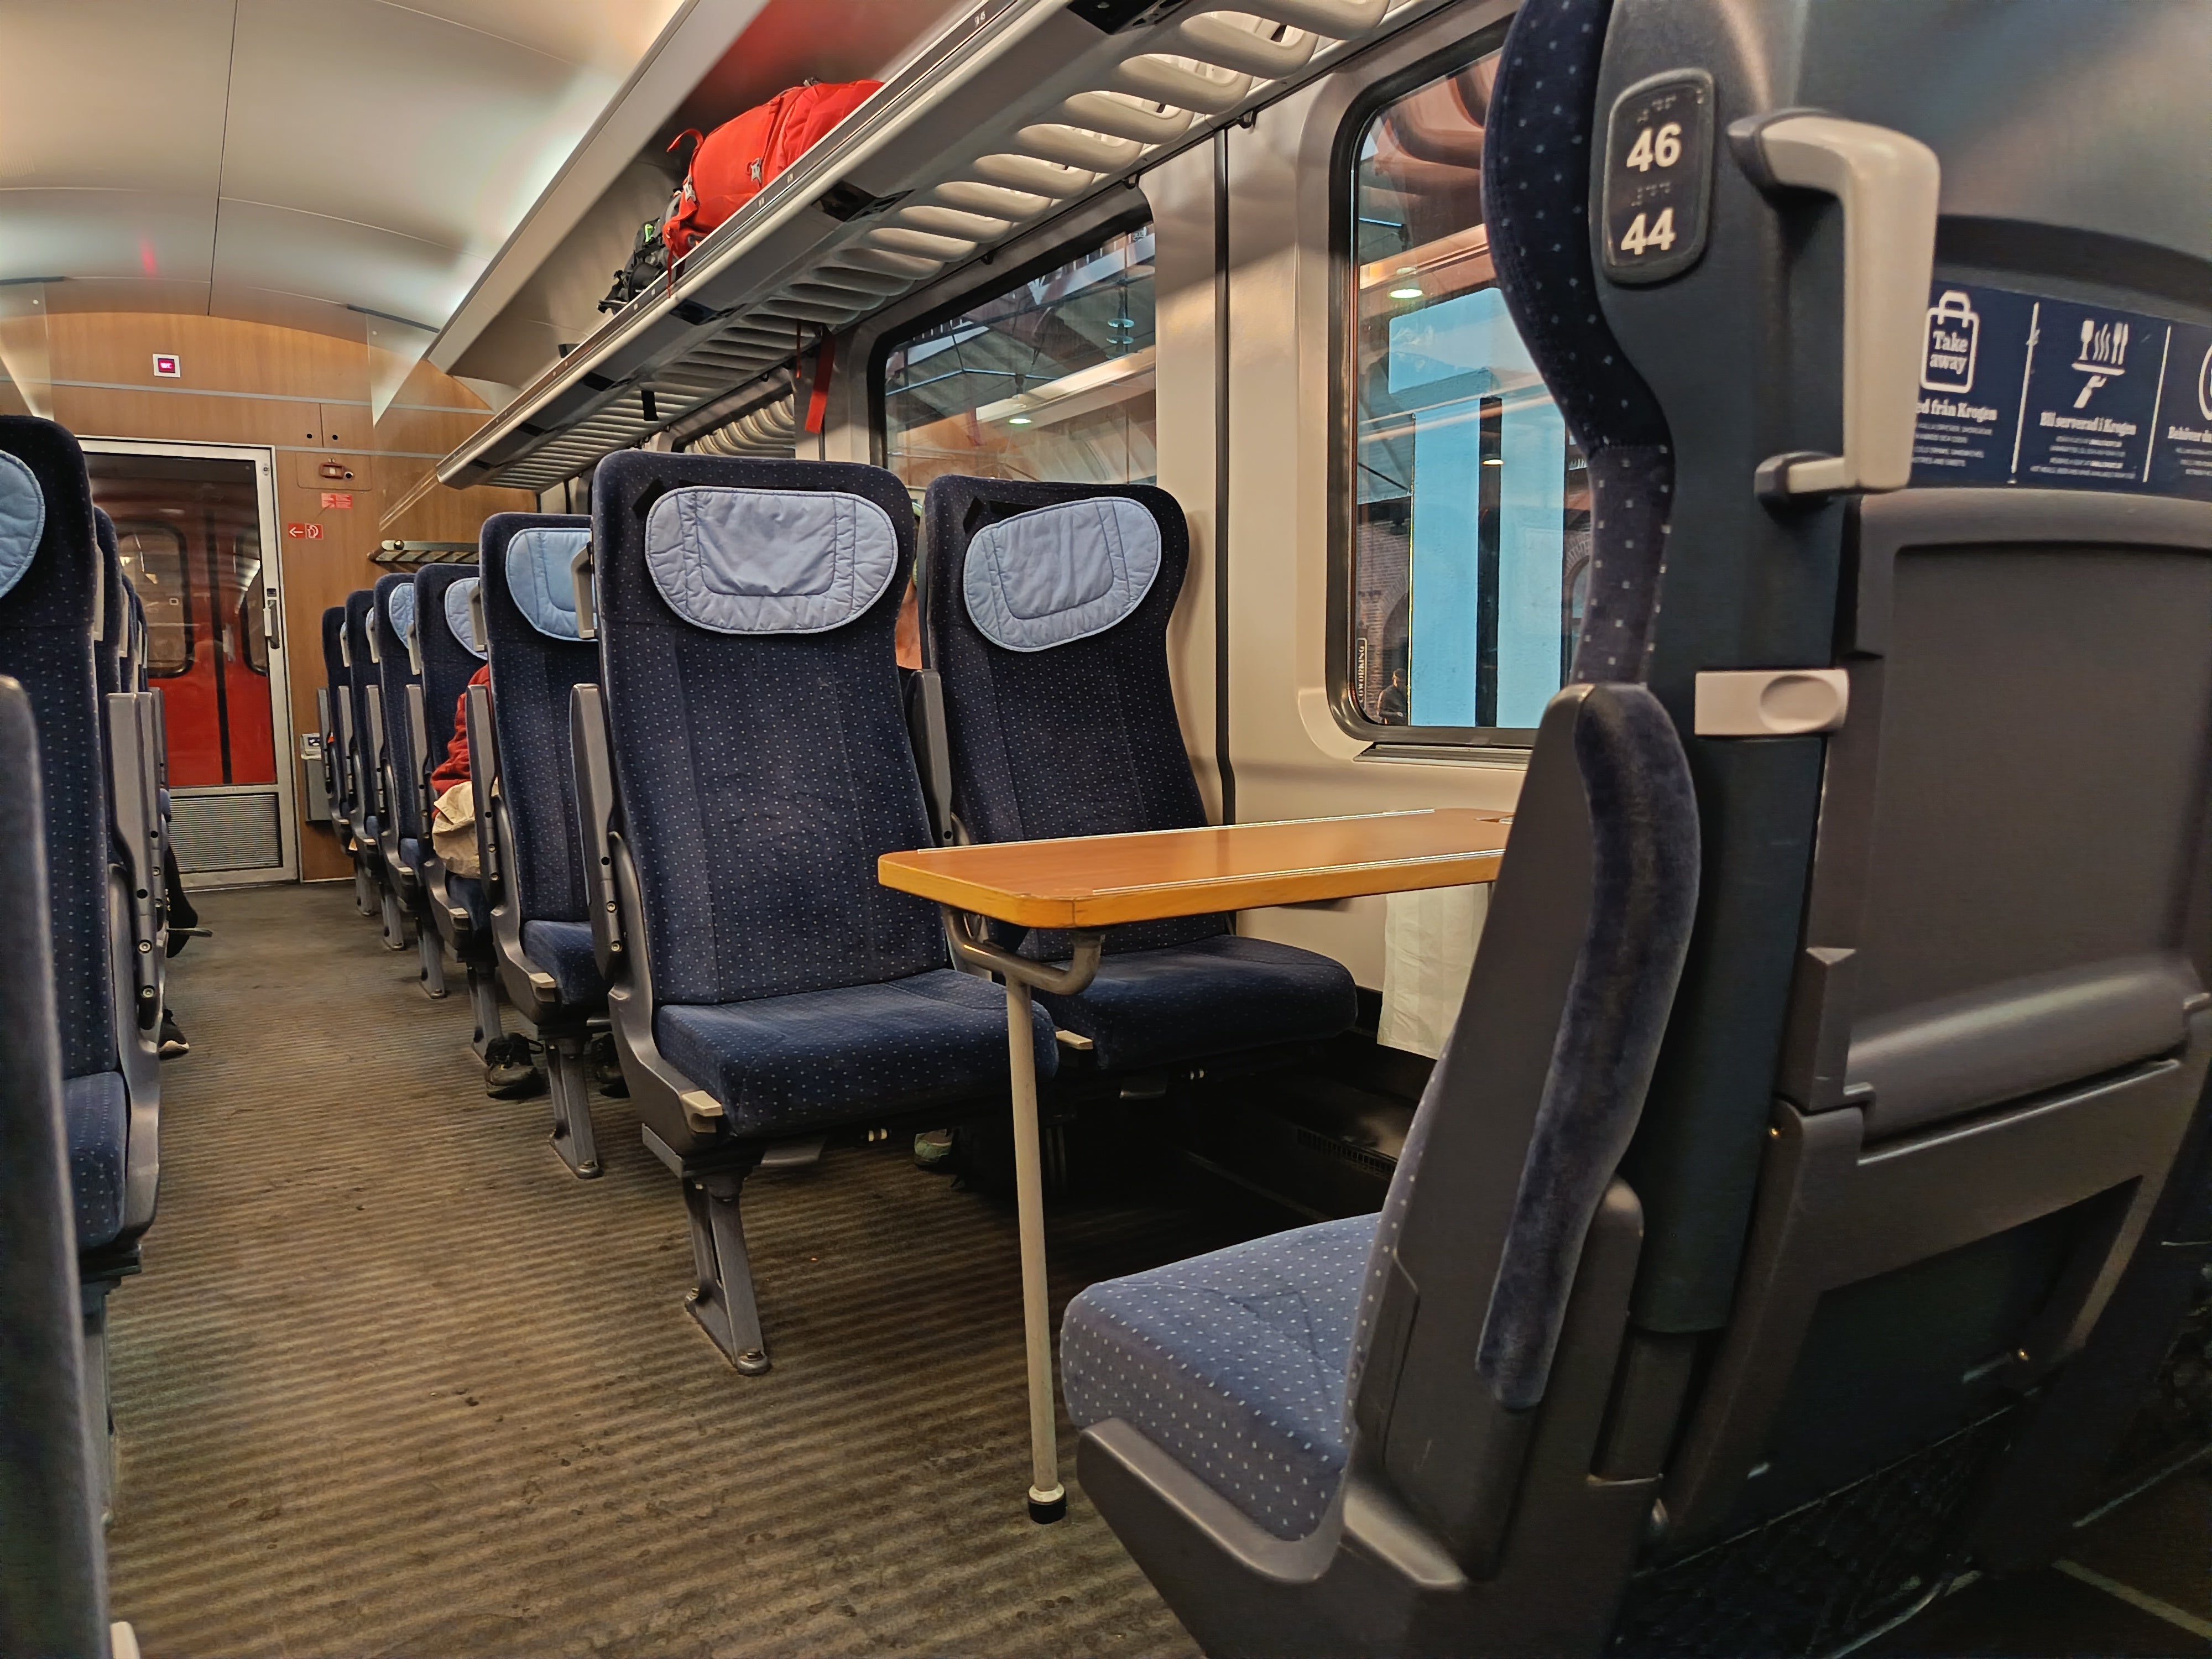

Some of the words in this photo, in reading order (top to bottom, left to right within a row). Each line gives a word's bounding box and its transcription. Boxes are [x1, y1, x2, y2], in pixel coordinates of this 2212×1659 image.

[1626, 122, 1682, 172] 46
[1621, 207, 1677, 255] 44
[1933, 331, 1969, 352] Take
[1929, 354, 1968, 374] away
[1914, 398, 1930, 414] ed
